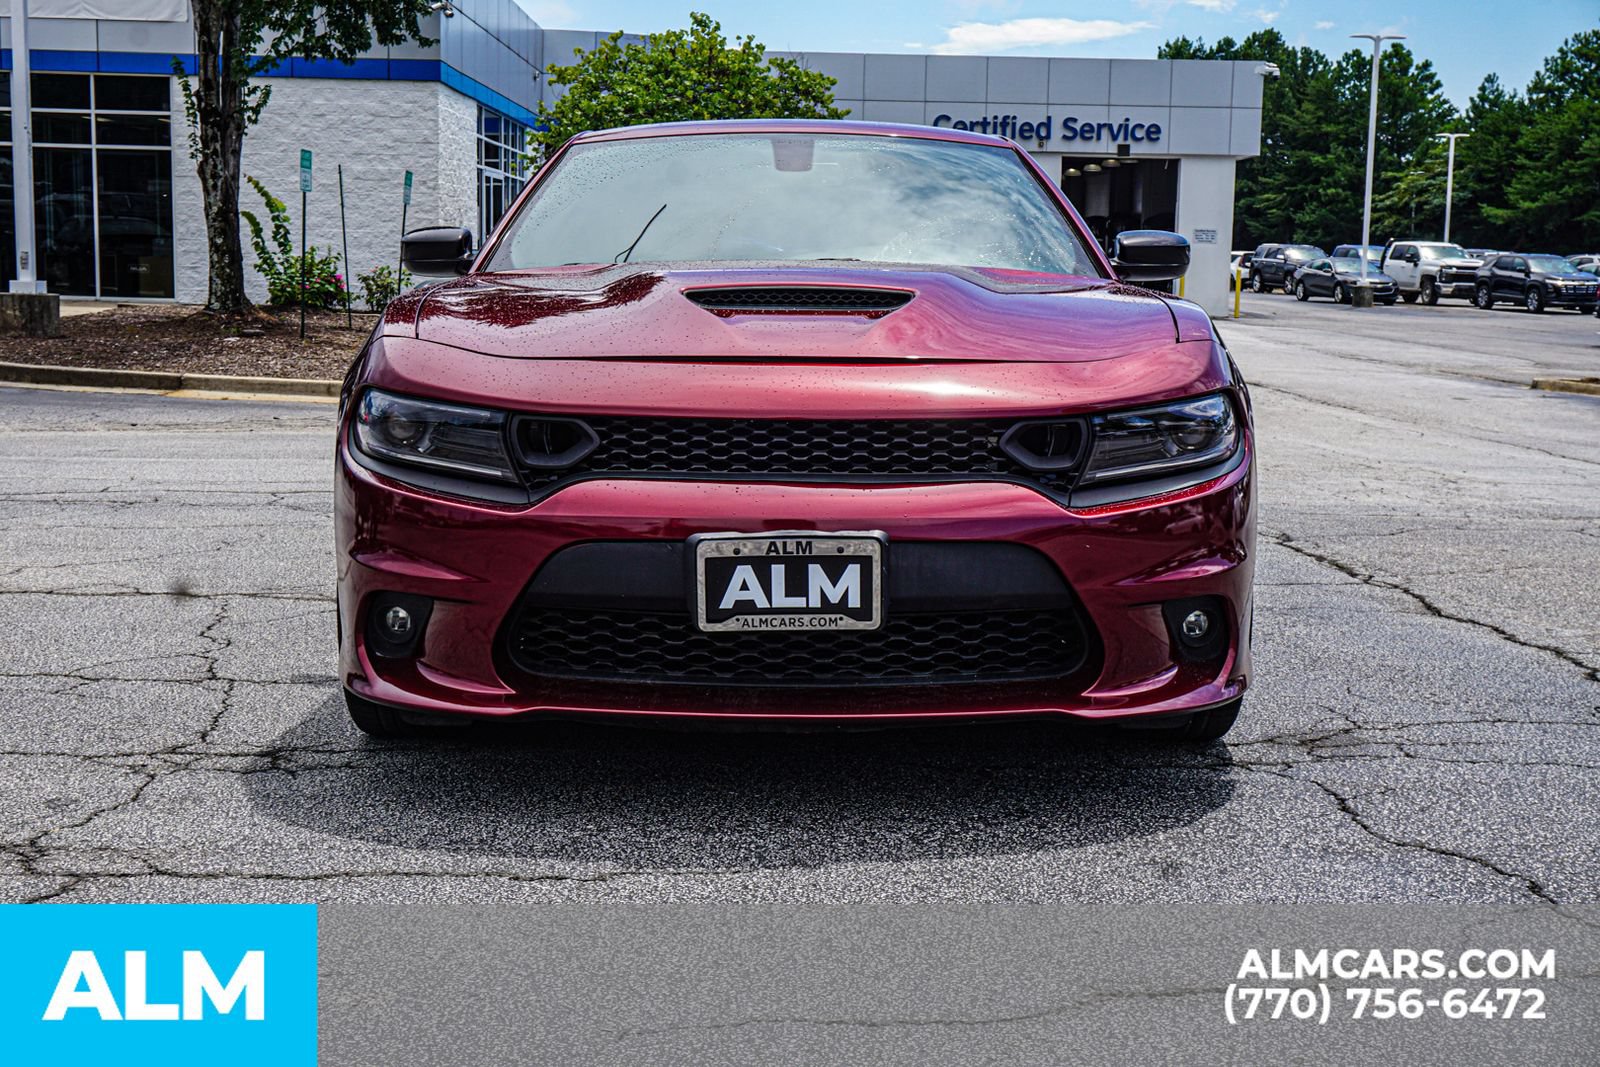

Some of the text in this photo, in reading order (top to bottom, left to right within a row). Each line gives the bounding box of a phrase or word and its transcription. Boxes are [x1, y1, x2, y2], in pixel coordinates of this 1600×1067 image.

[1061, 116, 1162, 142] Service
[765, 540, 813, 555] ALM
[718, 563, 861, 610] ALM
[742, 616, 838, 628] ALMCARS.COM
